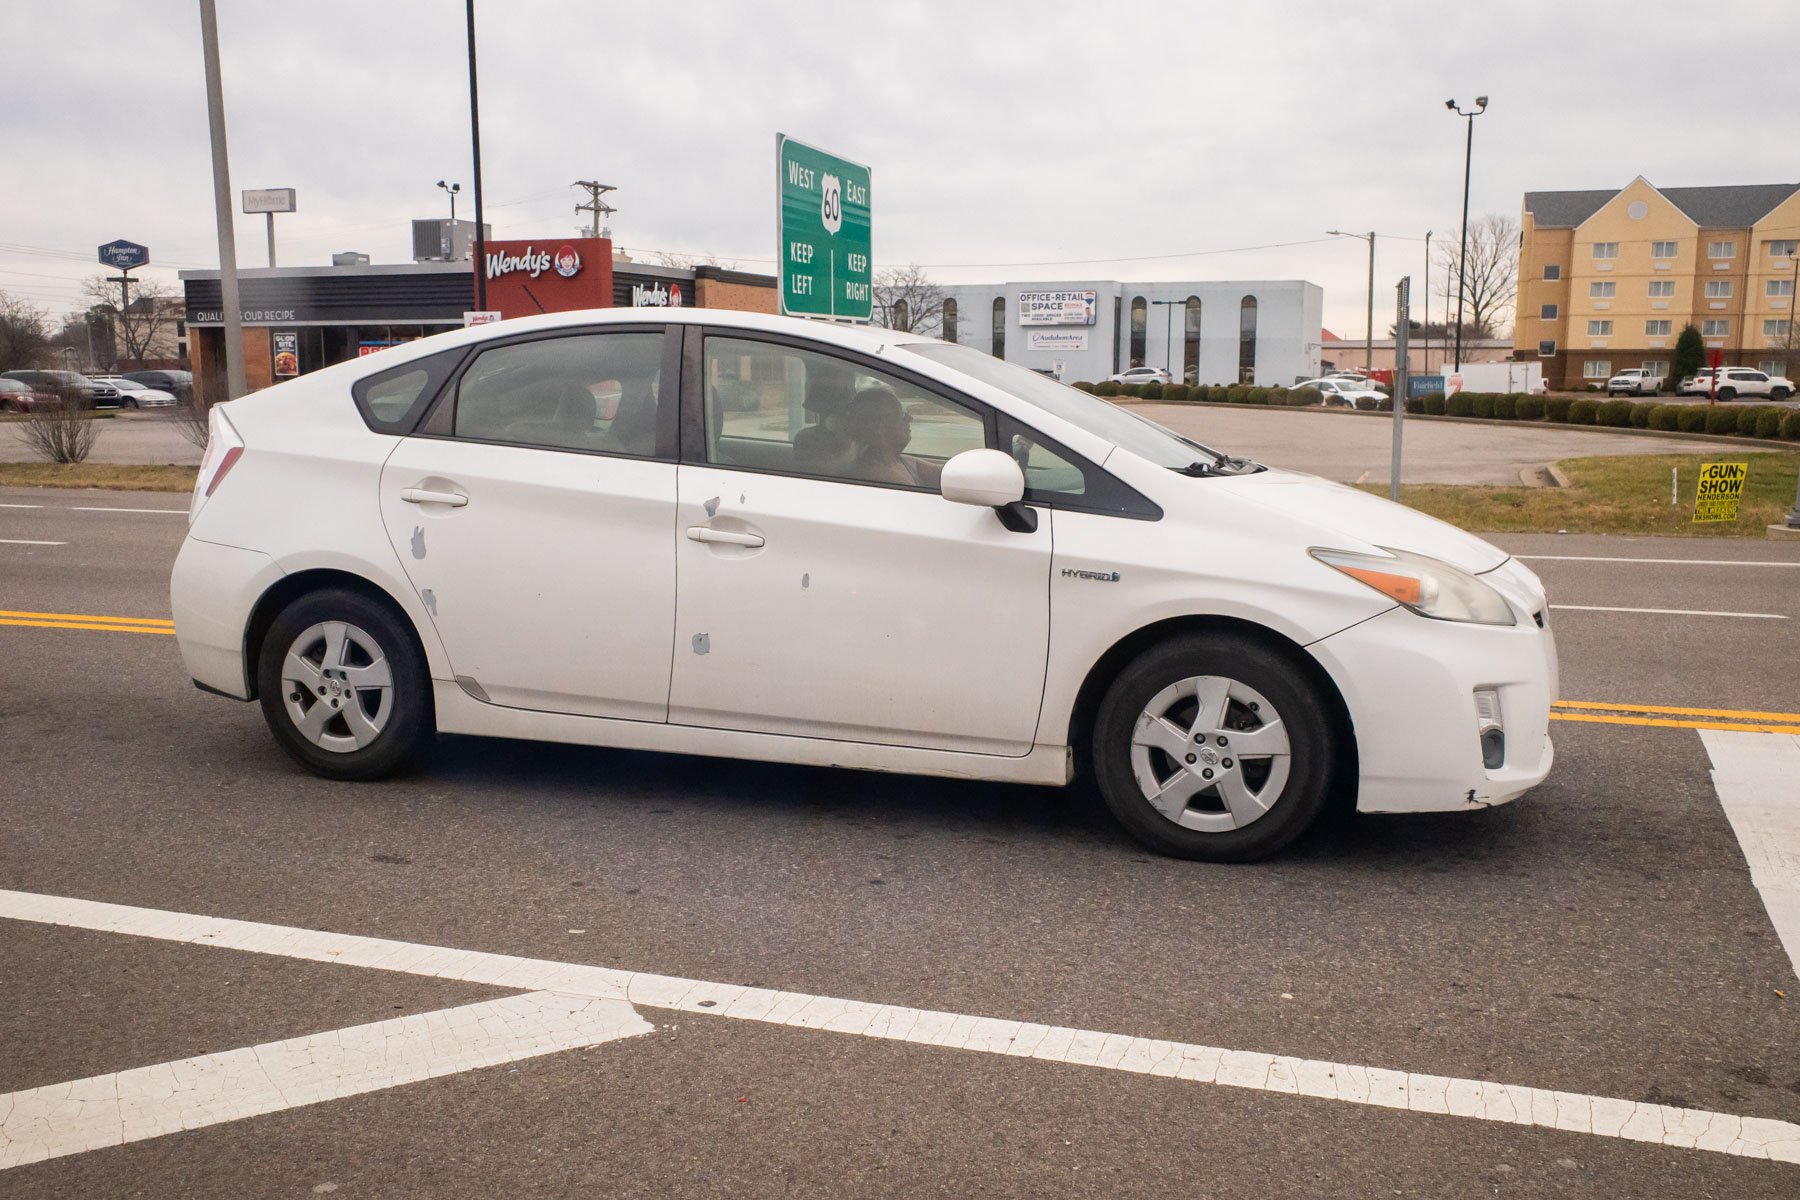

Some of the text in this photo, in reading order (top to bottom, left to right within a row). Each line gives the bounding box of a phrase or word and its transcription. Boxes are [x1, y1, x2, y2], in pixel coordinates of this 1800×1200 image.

[788, 160, 815, 191] WEST
[847, 180, 866, 205] EAST
[824, 189, 839, 222] 60
[104, 246, 141, 256] Hampton
[113, 254, 133, 262] Inn
[790, 241, 813, 264] KEEP
[486, 246, 551, 279] Wendy's
[848, 253, 867, 272] KEEP
[792, 273, 813, 295] LEFT
[846, 281, 869, 301] RIGHT
[632, 281, 668, 307] Wendy's
[1020, 293, 1085, 302] OFFICE-RETAIL
[1031, 302, 1063, 310] SPACE
[197, 311, 225, 321] QUALI
[244, 311, 263, 321] OUR
[264, 310, 295, 320] RECIPE
[1709, 465, 1739, 479] GUN
[1700, 480, 1742, 494] SHOW
[1697, 493, 1740, 501] HENDERSON
[1062, 569, 1111, 581] HYBRID
